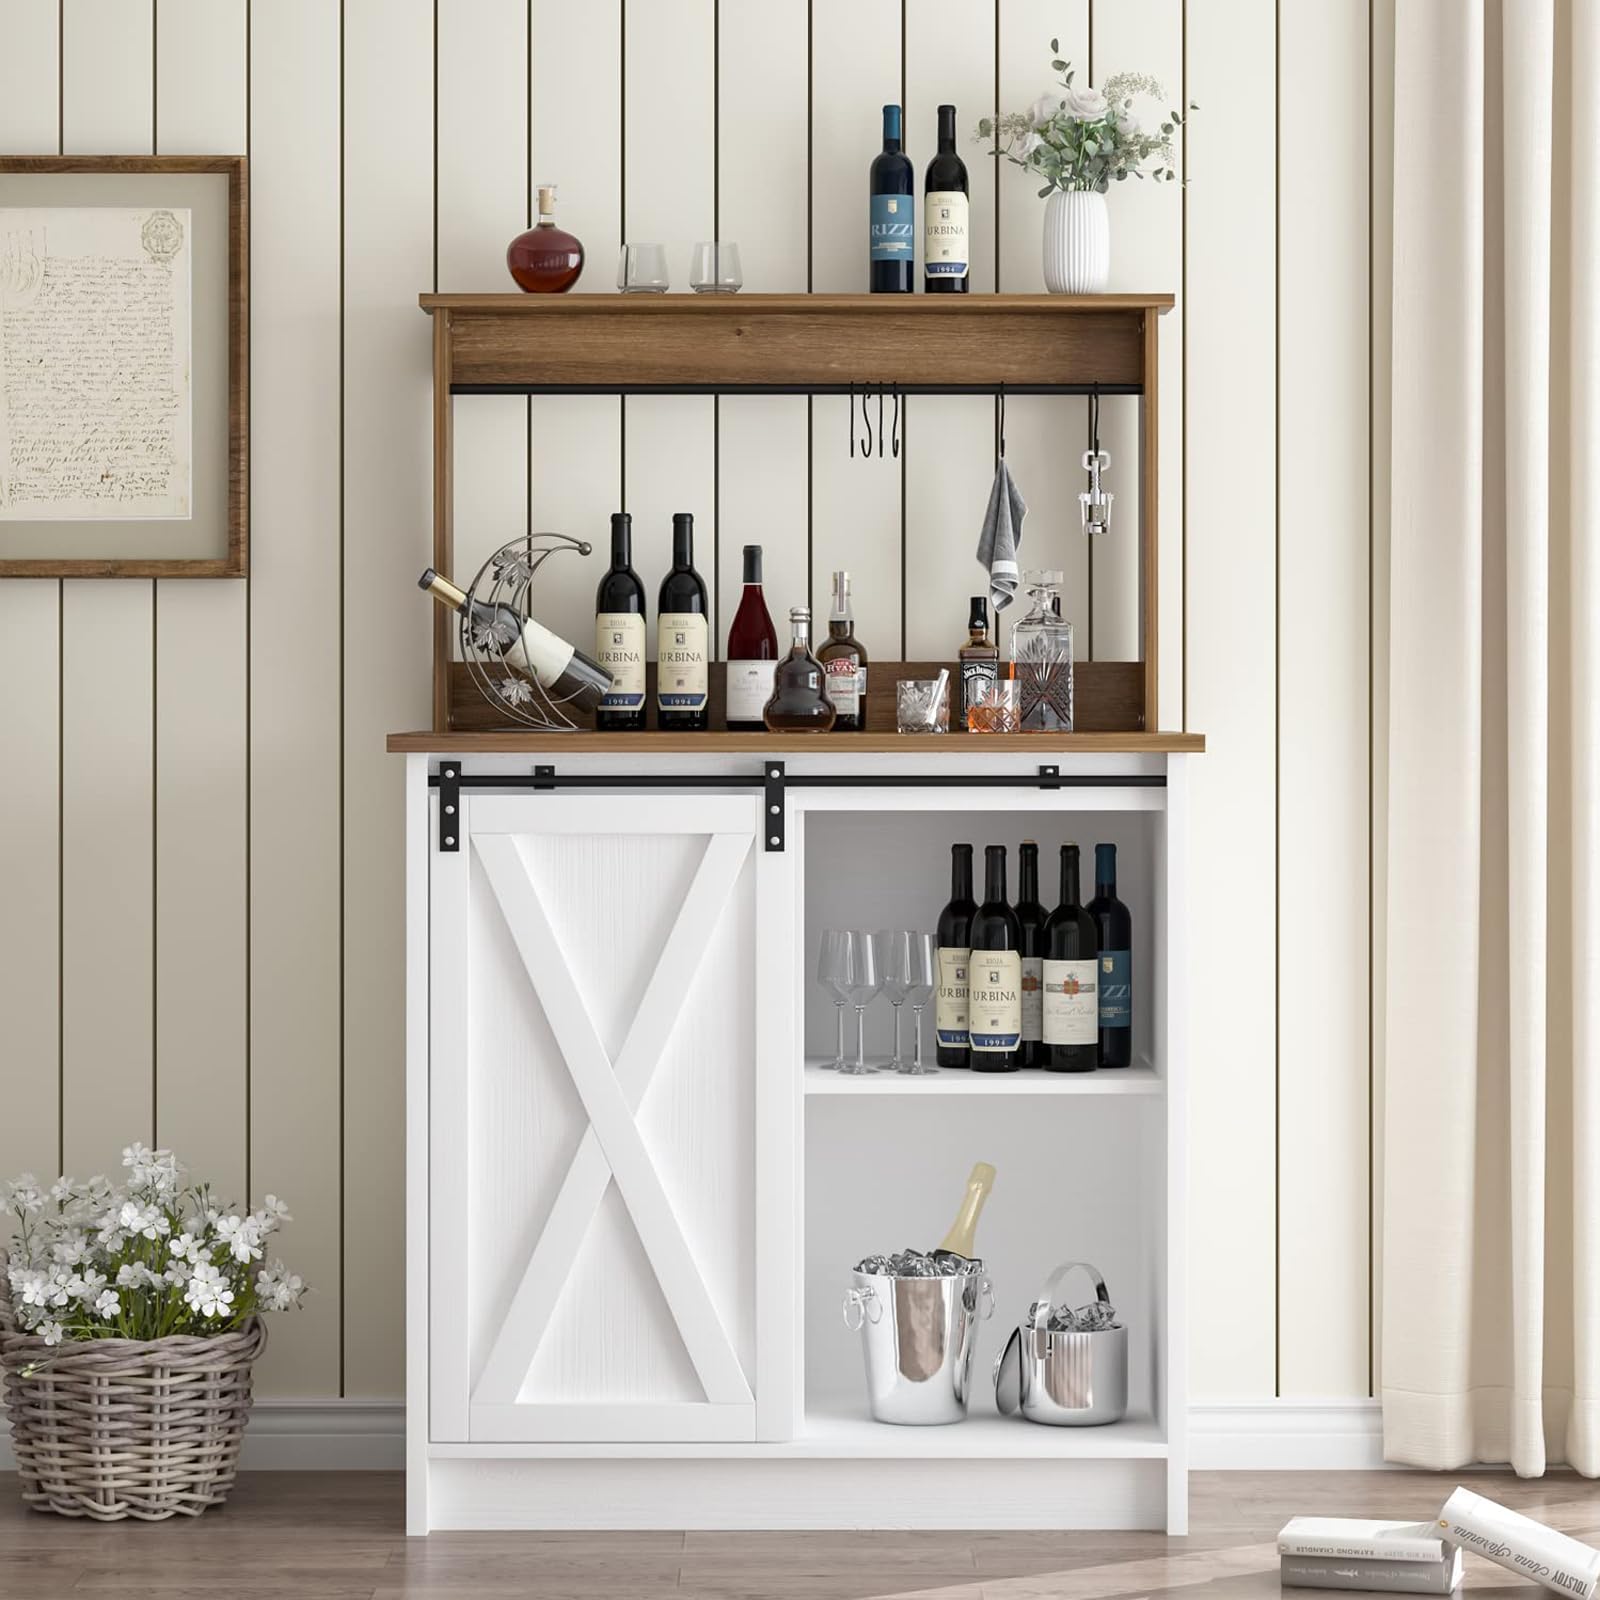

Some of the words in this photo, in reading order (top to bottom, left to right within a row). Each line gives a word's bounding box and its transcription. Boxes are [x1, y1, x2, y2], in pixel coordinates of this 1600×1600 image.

[927, 225, 965, 235] URBINA
[598, 651, 640, 663] URBINA
[660, 651, 701, 663] URBINA
[827, 664, 856, 673] RYAN
[608, 697, 629, 705] 1994
[670, 697, 691, 705] 1994
[972, 990, 1017, 1002] URBINA
[984, 1039, 1006, 1047] 1994
[1453, 1525, 1512, 1558] Karenina
[1296, 1545, 1334, 1554] CHANDLER
[1337, 1547, 1375, 1556] RAYMOND
[1513, 1554, 1550, 1577] Anna
[1551, 1570, 1588, 1596] TOLSTOY
